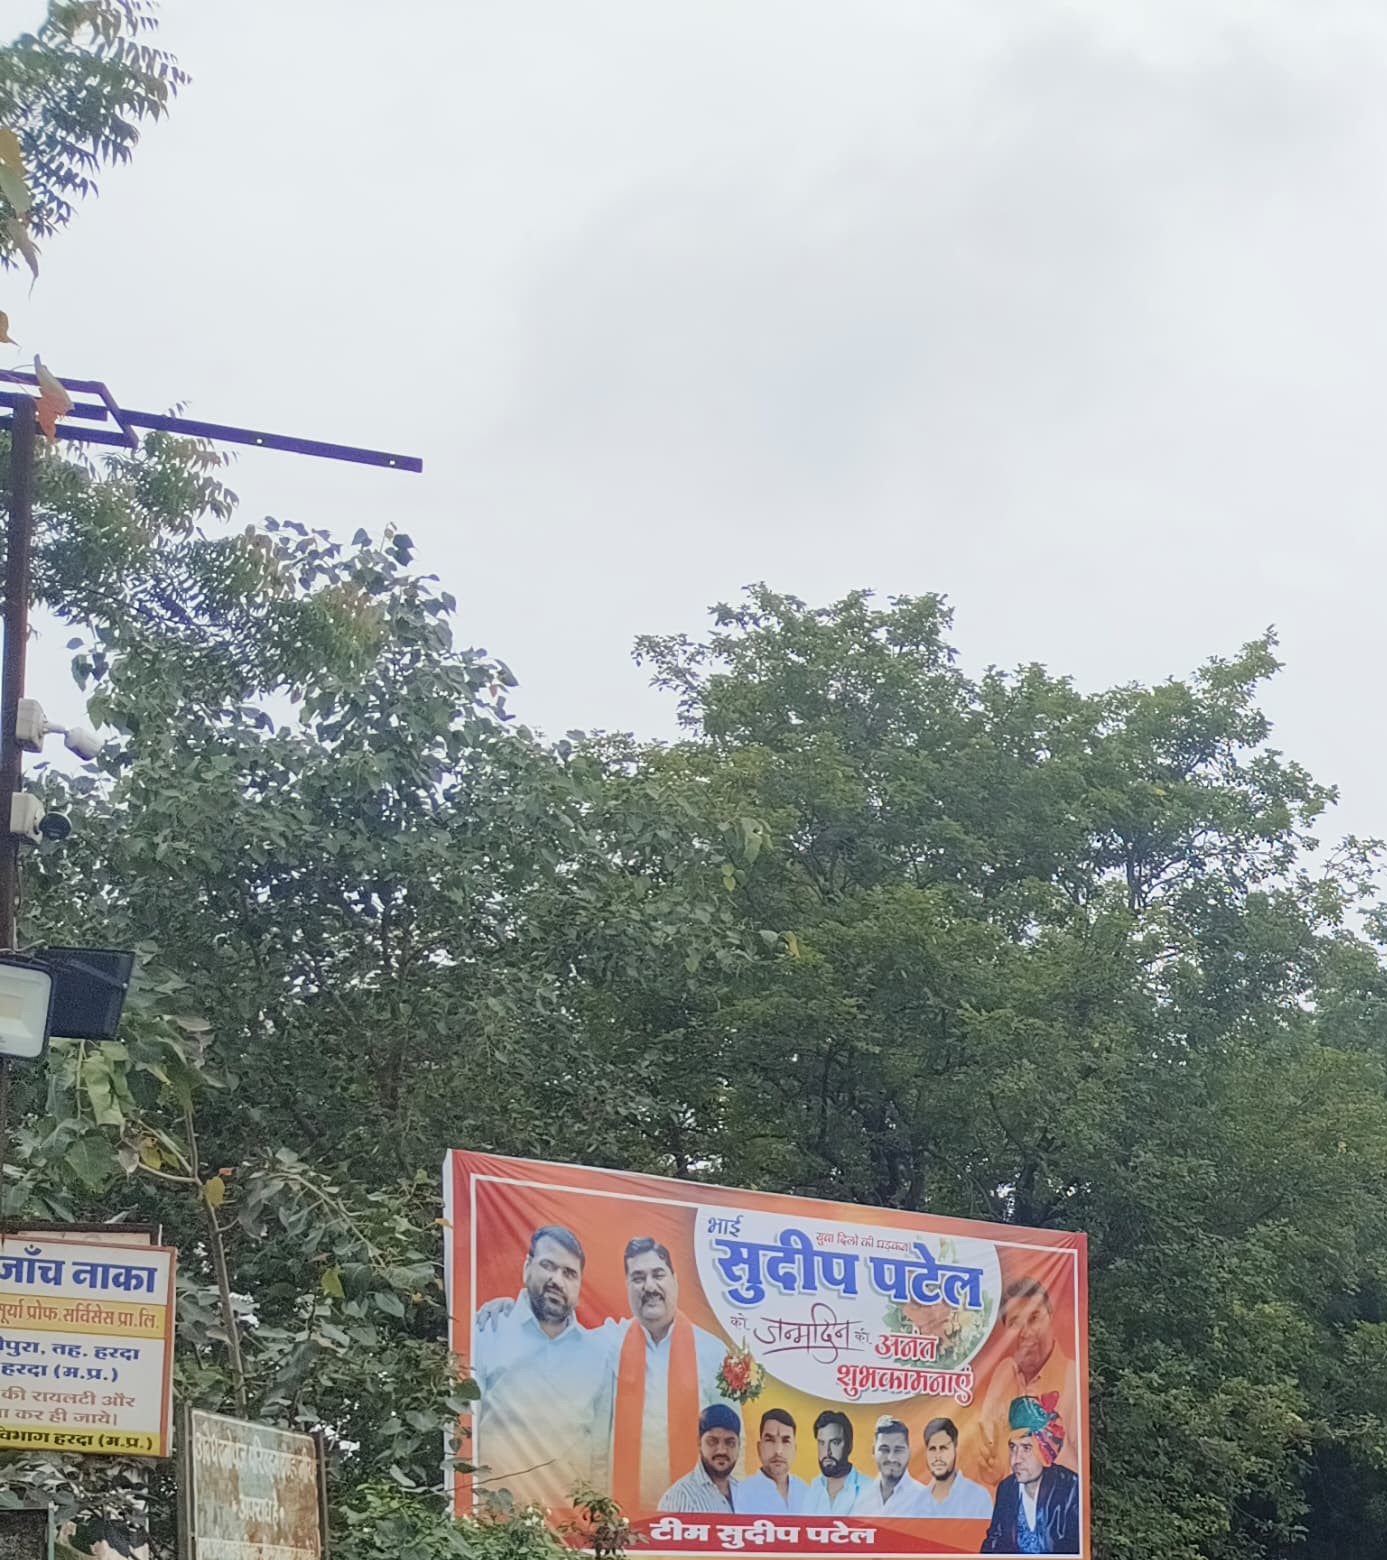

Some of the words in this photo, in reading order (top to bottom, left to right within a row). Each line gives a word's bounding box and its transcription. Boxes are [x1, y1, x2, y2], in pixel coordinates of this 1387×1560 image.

[707, 1215, 744, 1237] भाई
[72, 1262, 158, 1293] नाका
[715, 1228, 859, 1305] सुदीप
[868, 1242, 984, 1308] पटेल
[753, 1302, 862, 1364] जन्मदिन
[875, 1326, 938, 1361] अनंत
[52, 1344, 88, 1358] तह.
[94, 1346, 141, 1361] हरदा
[1, 1362, 48, 1378] हरदा
[54, 1364, 118, 1382] (म.प्र.)
[1, 1385, 27, 1401] की
[32, 1391, 96, 1406] रायलटी
[102, 1393, 136, 1408] और
[15, 1409, 43, 1421] कर
[49, 1408, 67, 1423] ही
[53, 1434, 94, 1447] हरदा
[649, 1517, 711, 1542] टीम
[716, 1519, 801, 1549] सुदीप
[806, 1520, 877, 1544] पटेल
